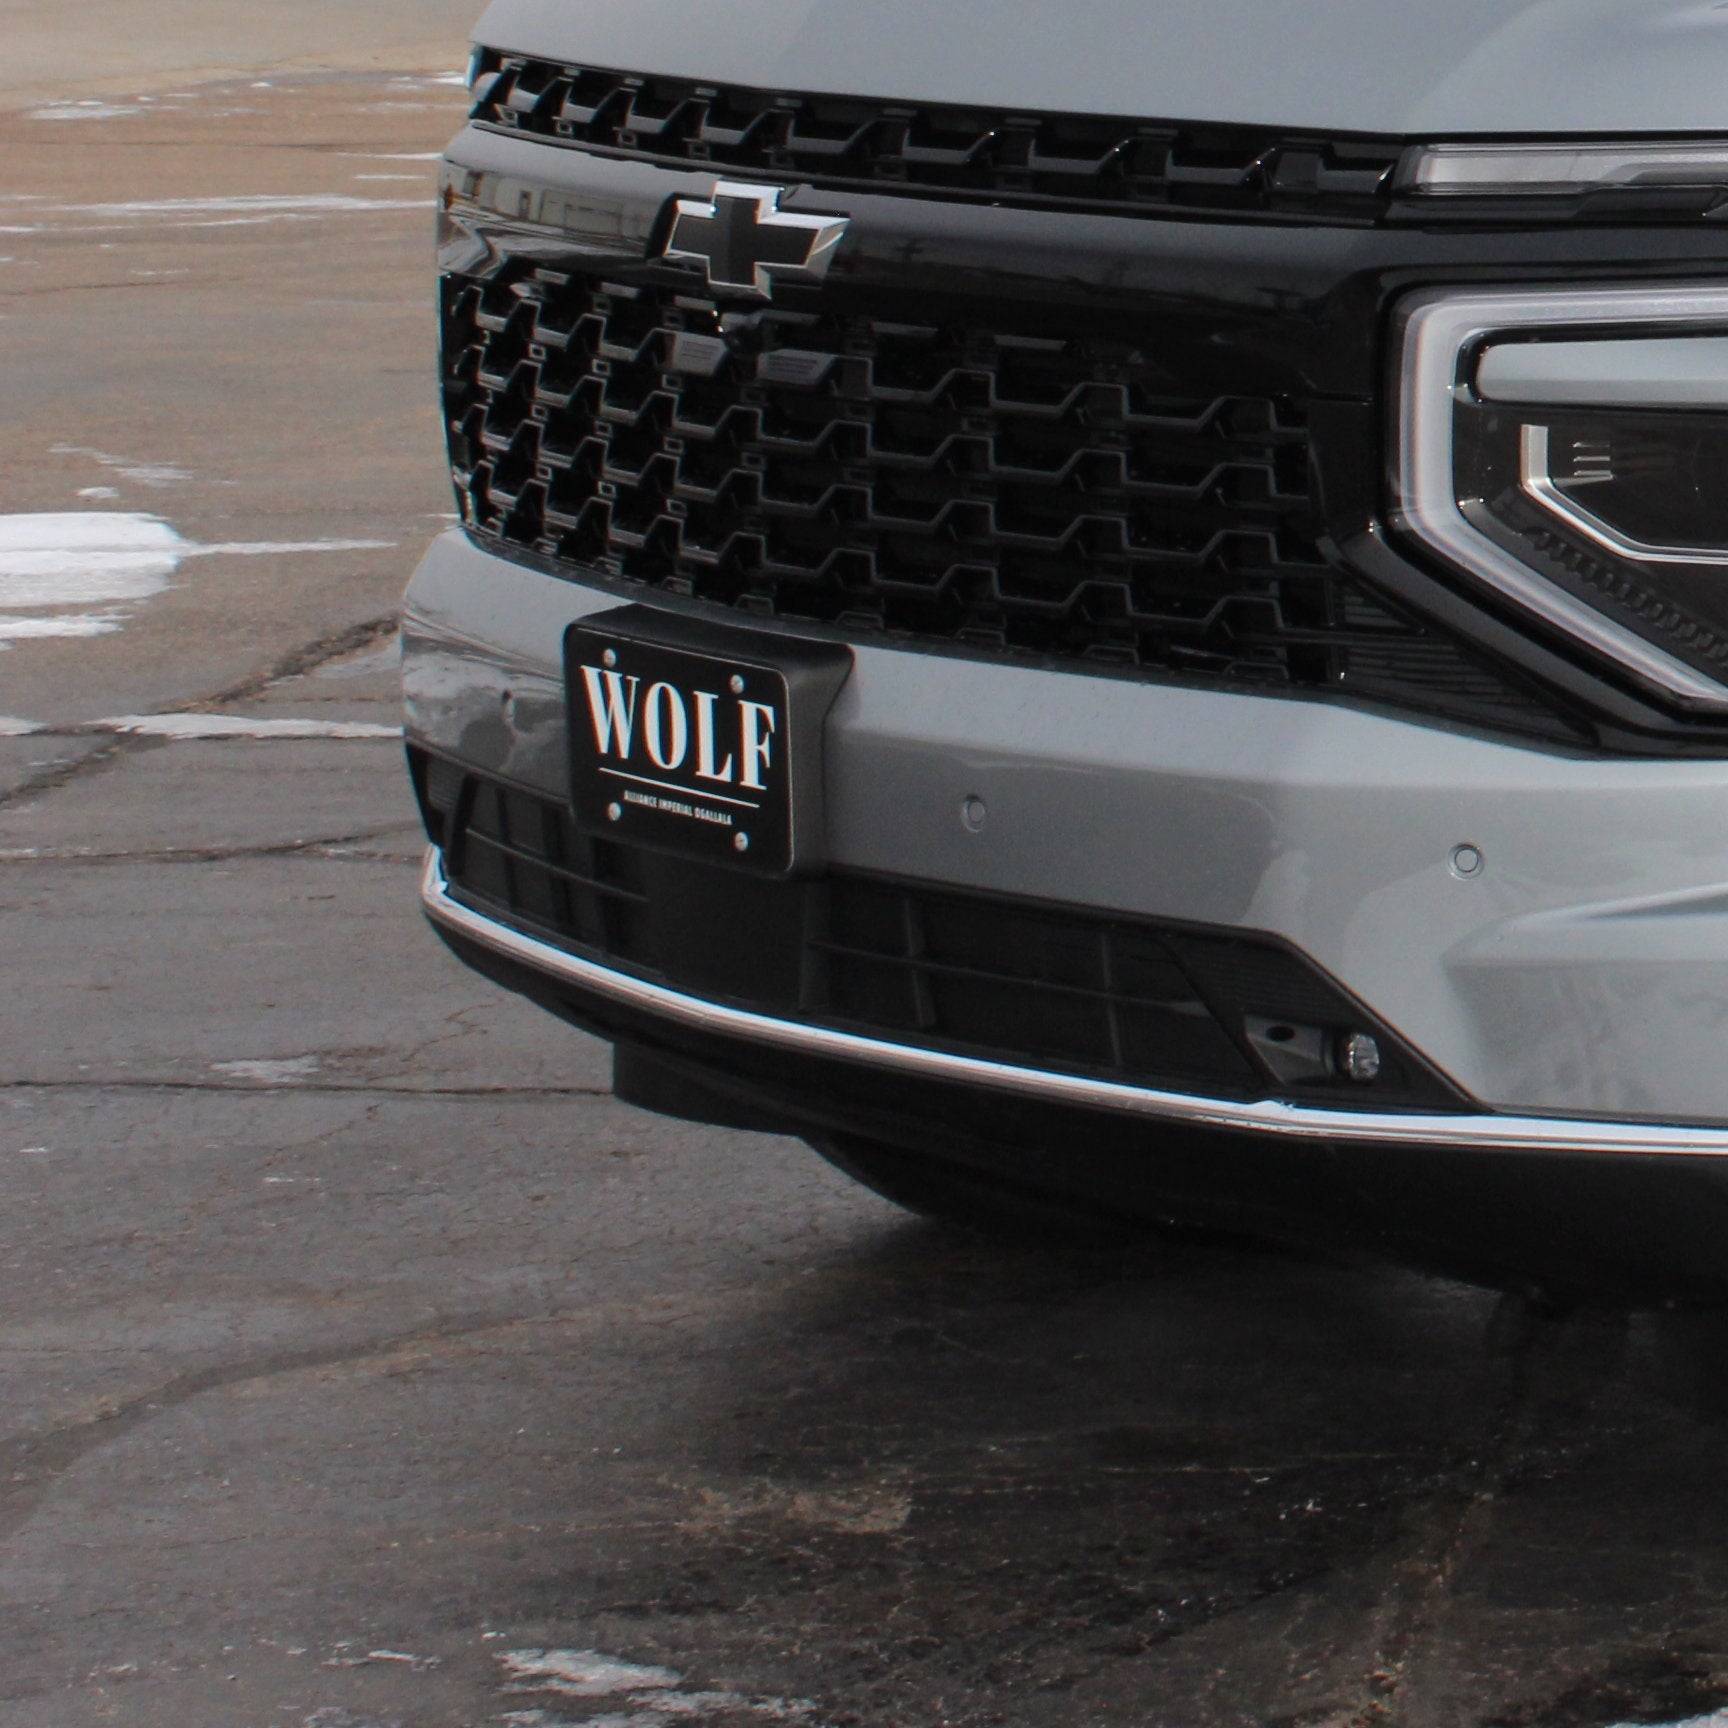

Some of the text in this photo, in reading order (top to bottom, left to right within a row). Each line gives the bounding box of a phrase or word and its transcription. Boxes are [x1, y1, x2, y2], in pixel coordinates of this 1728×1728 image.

[581, 665, 775, 790] WOLF
[623, 789, 733, 826] ALLIANCE IMPERIAL OGALLALA
